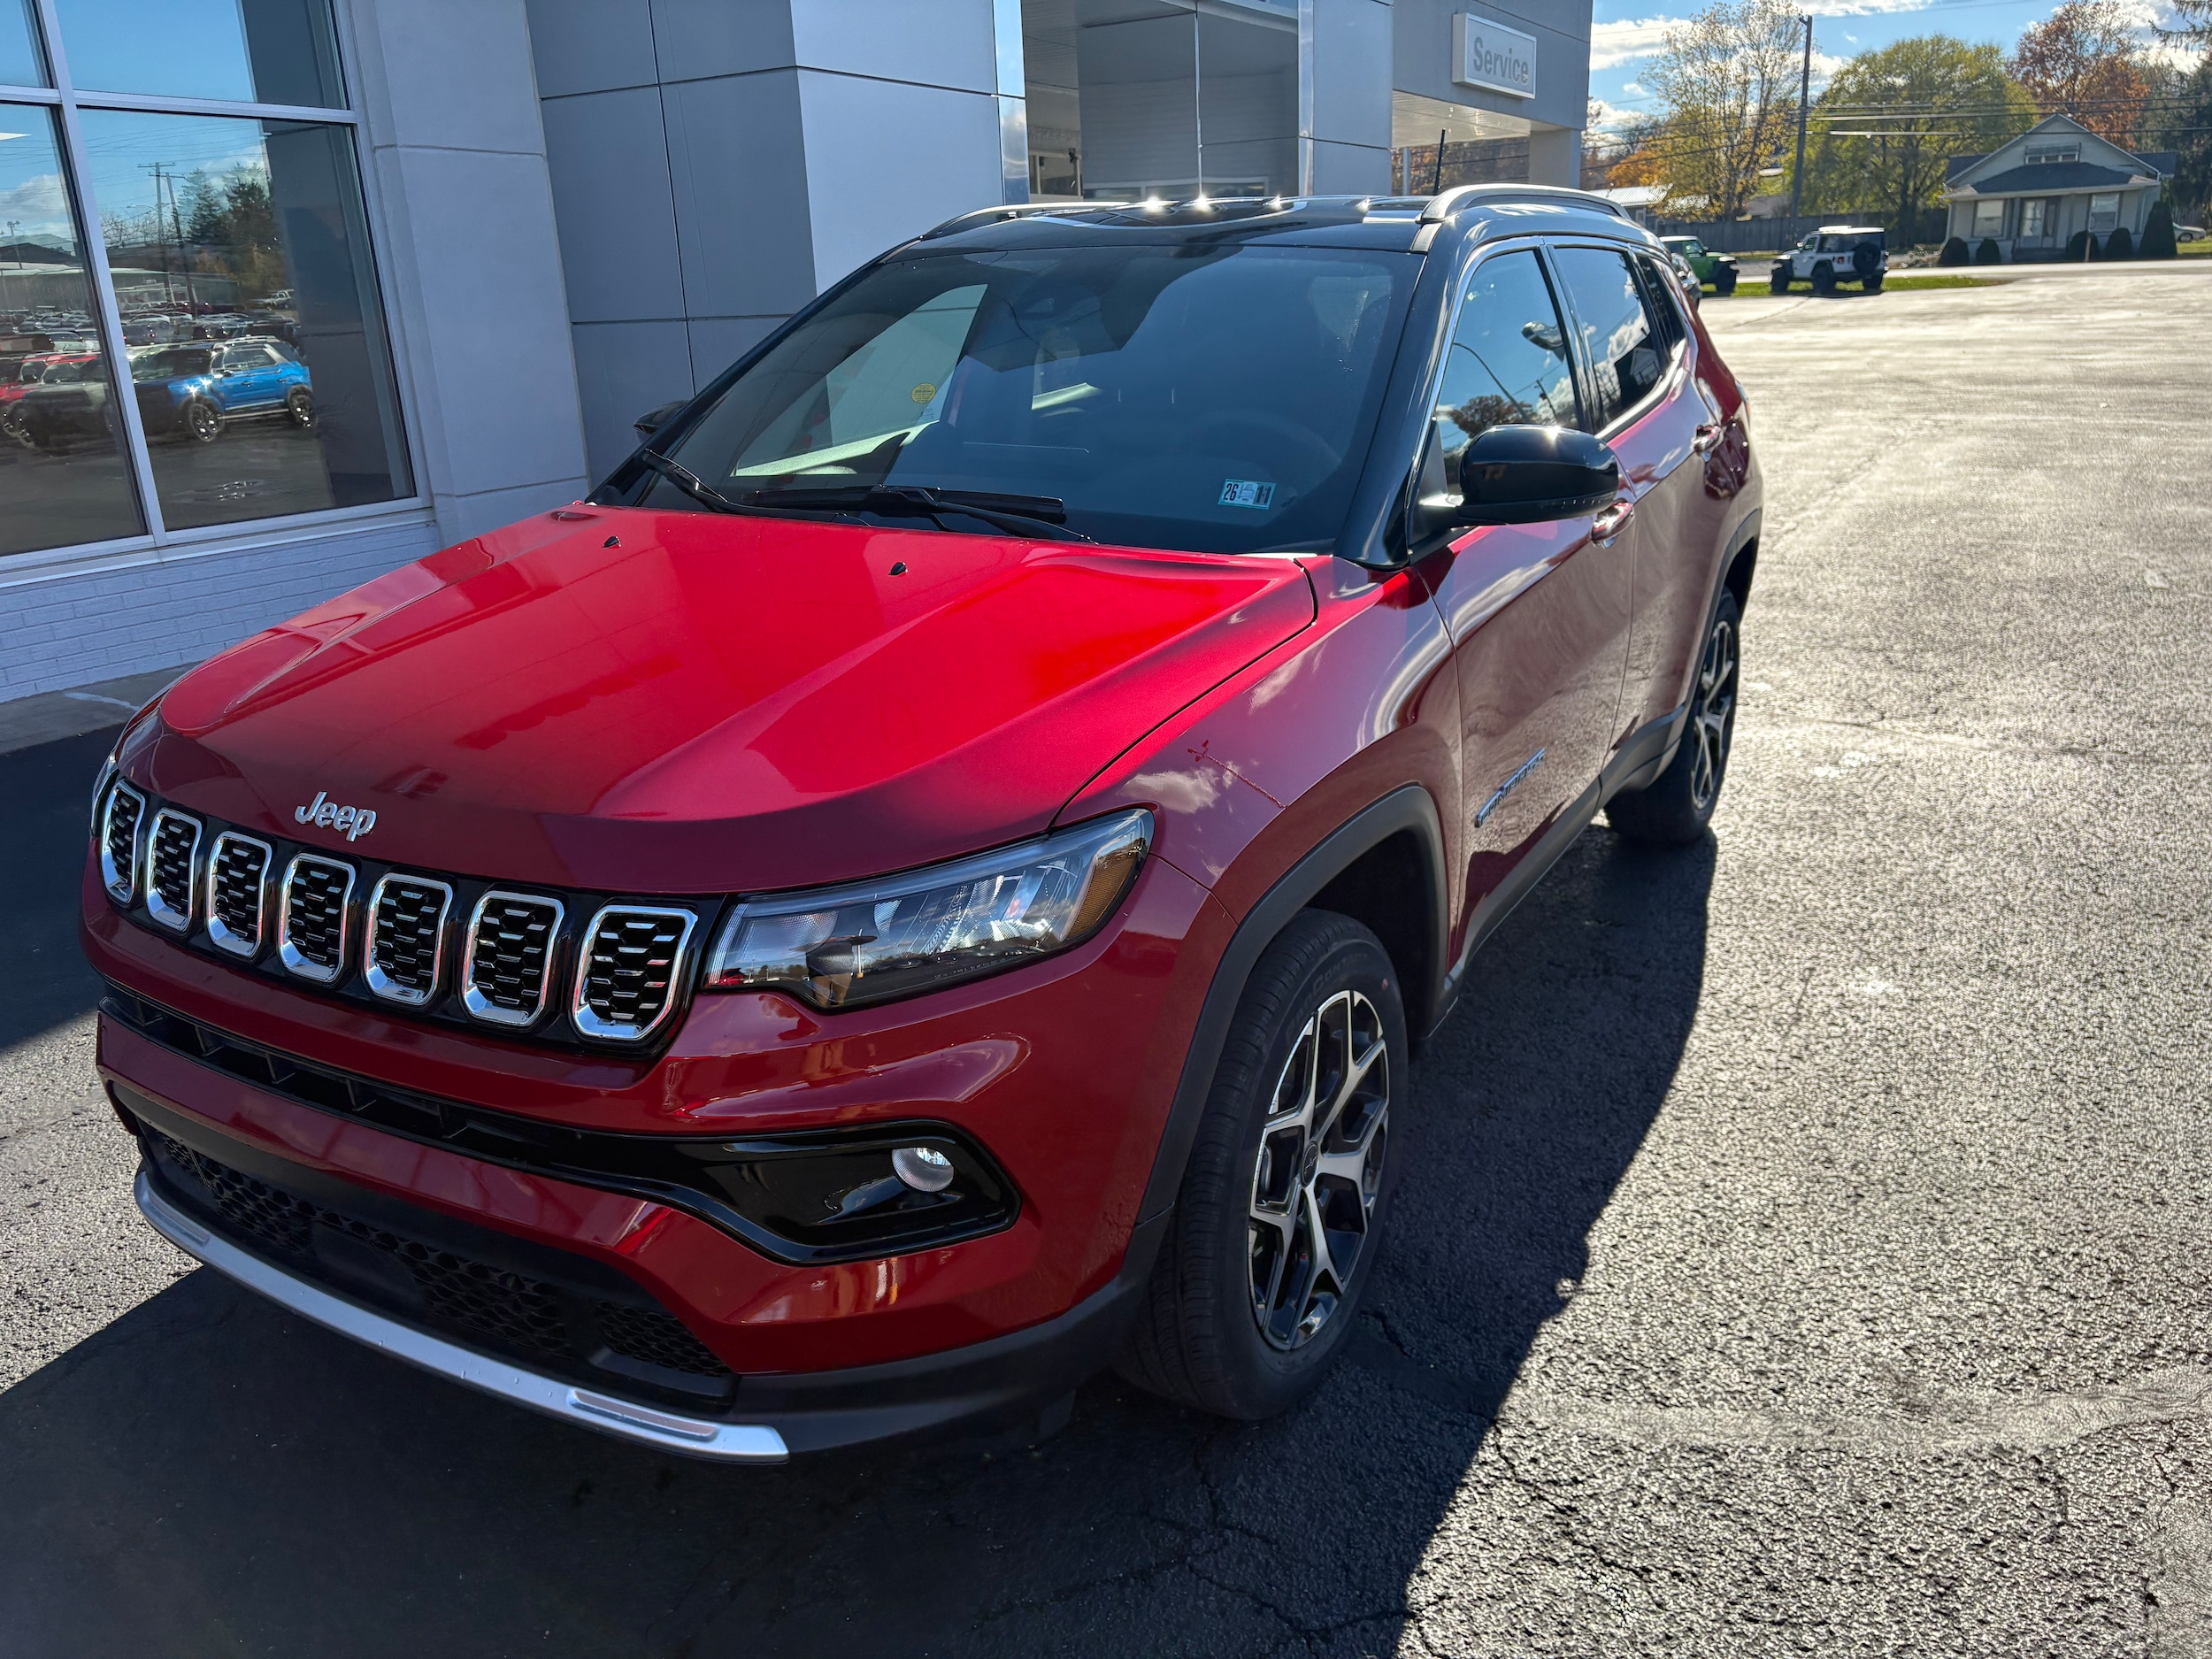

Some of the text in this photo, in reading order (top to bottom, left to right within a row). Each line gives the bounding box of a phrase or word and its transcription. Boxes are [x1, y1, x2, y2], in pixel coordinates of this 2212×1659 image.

[1473, 36, 1529, 85] Service
[1223, 483, 1271, 504] 26 11
[294, 791, 377, 842] Jeep
